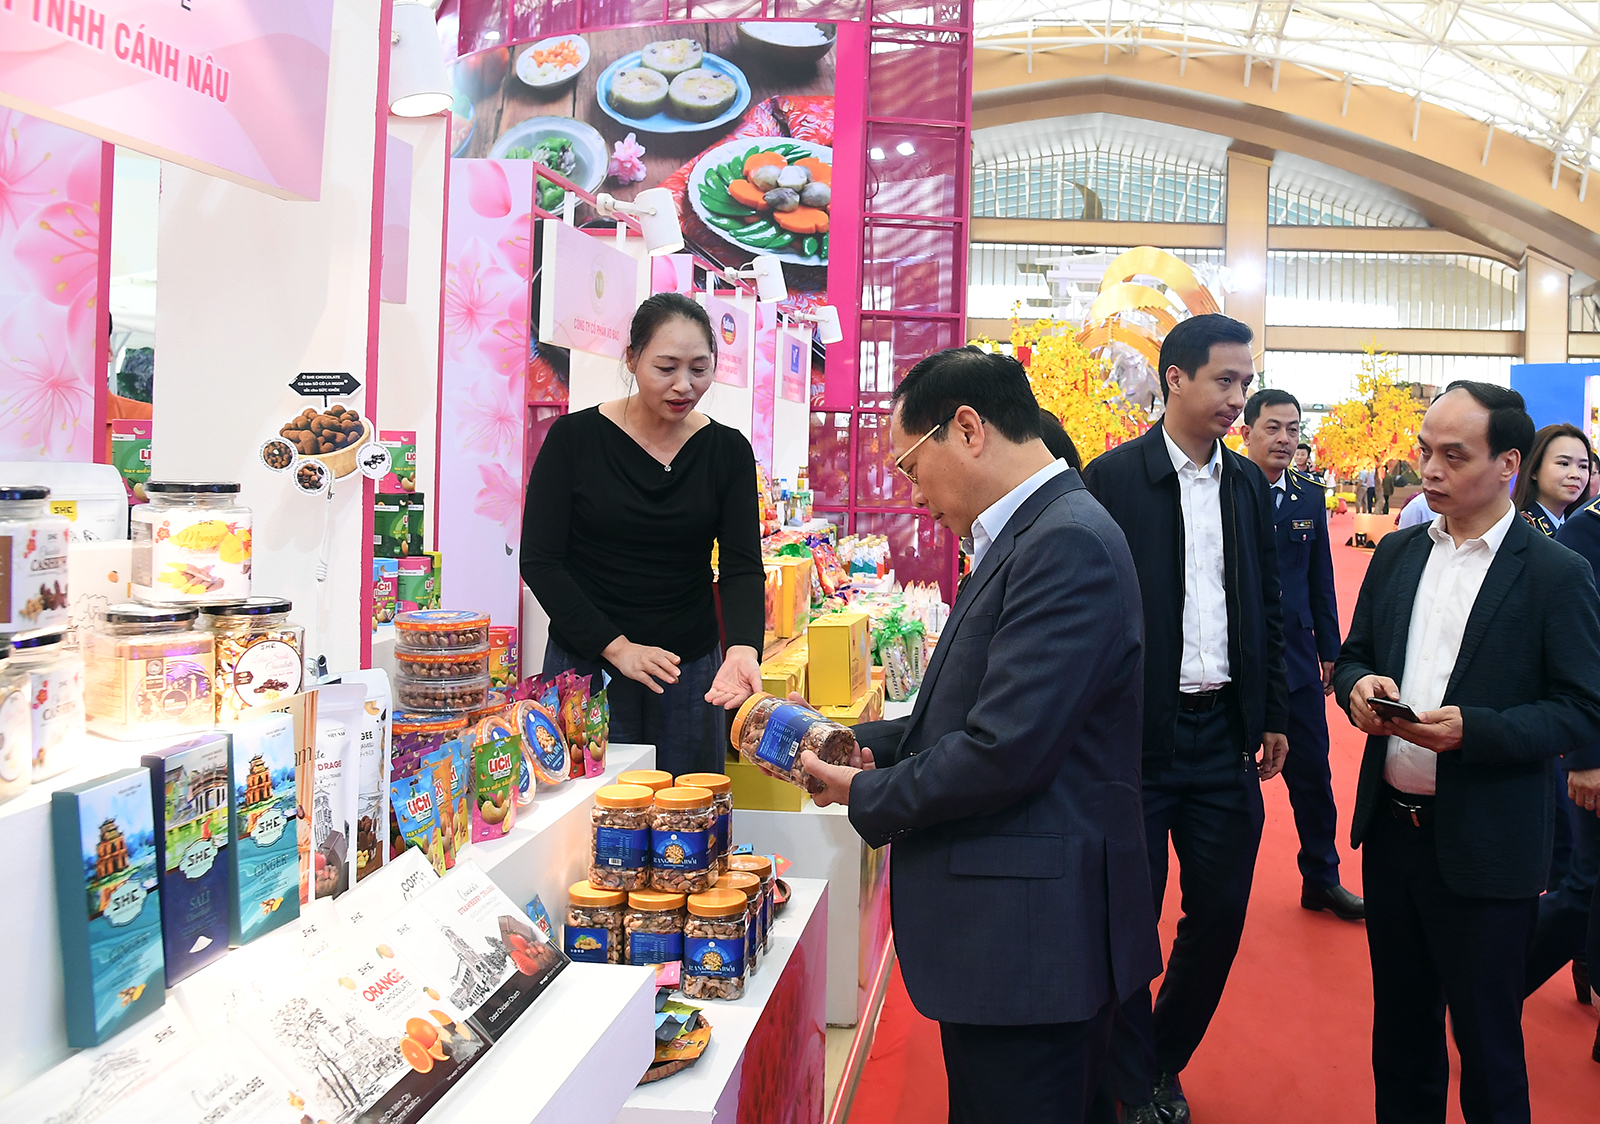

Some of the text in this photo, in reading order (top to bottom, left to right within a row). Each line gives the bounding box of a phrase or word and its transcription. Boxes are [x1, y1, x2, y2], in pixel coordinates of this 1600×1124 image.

[114, 22, 180, 83] CÁNH
[186, 56, 229, 102] NÂU
[54, 506, 74, 514] SHE
[176, 529, 219, 546] Mango
[261, 643, 276, 651] SHE
[489, 754, 511, 773] LICH
[407, 793, 432, 815] LICH
[258, 815, 282, 834] SHE
[187, 847, 211, 868] SHE
[254, 853, 287, 878] GINGER
[113, 888, 140, 912] SHE
[189, 890, 210, 911] SALT
[303, 924, 318, 938] SHE
[358, 962, 375, 976] SHE
[362, 968, 405, 1002] ORANGE
[154, 1024, 176, 1044] SHE
